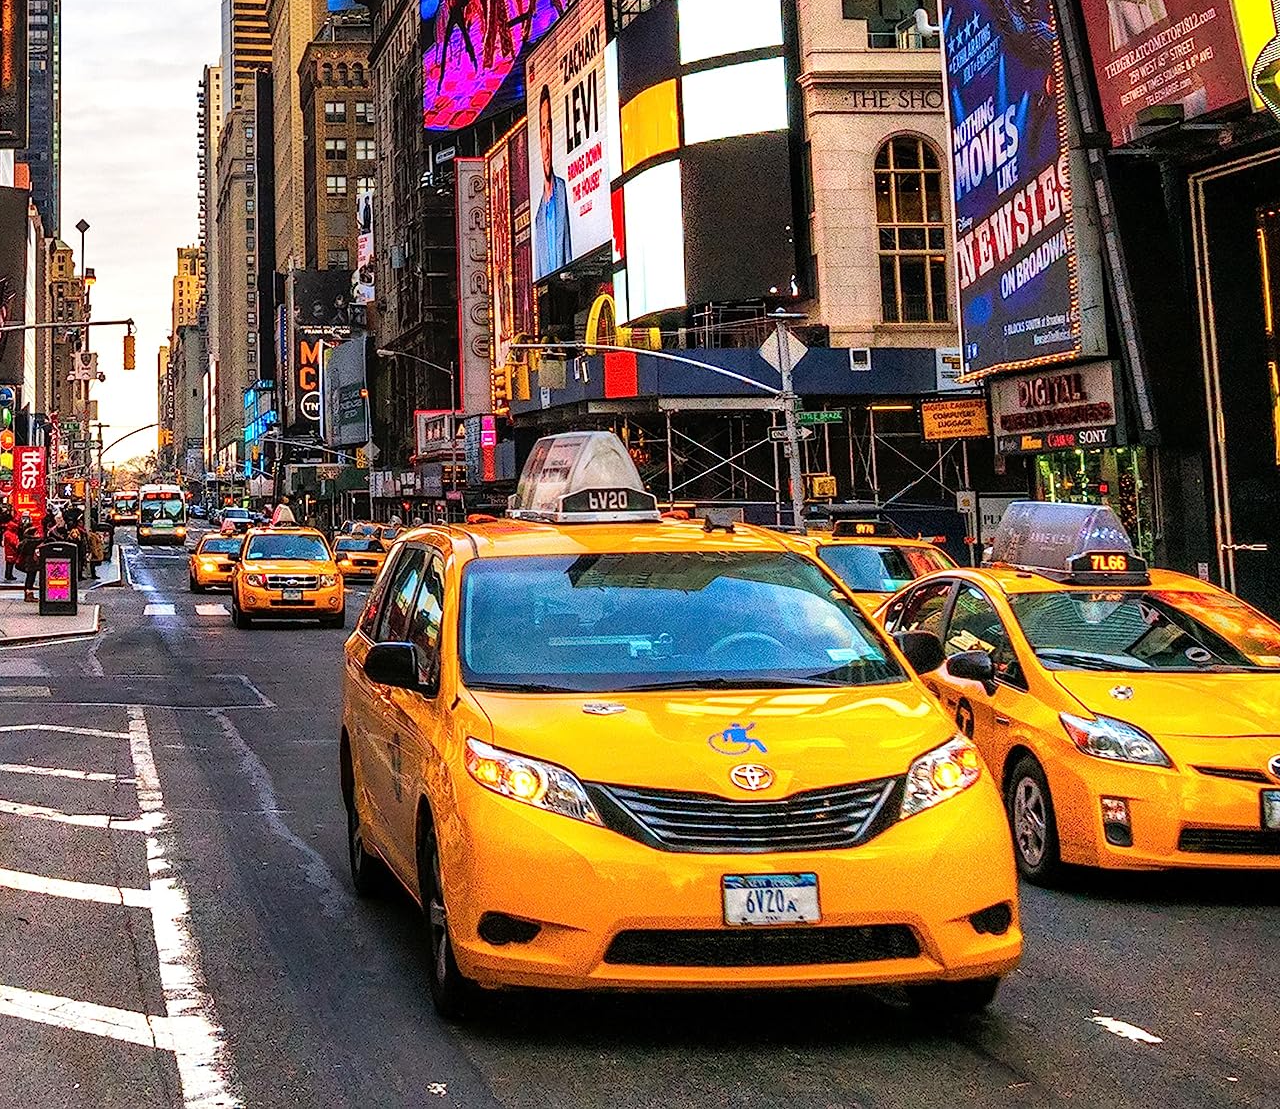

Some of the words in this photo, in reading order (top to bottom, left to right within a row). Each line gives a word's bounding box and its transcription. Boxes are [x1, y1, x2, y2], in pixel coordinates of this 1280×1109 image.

[1139, 58, 1158, 81] WEST
[1169, 38, 1195, 64] STREET
[564, 68, 599, 154] LEVI
[953, 96, 995, 152] NOTHING
[585, 141, 602, 171] DOWN
[955, 104, 1019, 201] MOVES
[572, 184, 582, 203] THE
[996, 157, 1019, 195] LIKE
[469, 174, 491, 358] PALACE
[1001, 269, 1016, 300] ON
[1017, 227, 1069, 287] BROADWA
[1018, 373, 1087, 409] DIGITAL
[1078, 430, 1108, 445] SONY
[21, 450, 41, 489] tkts
[1091, 555, 1127, 571] 7L66
